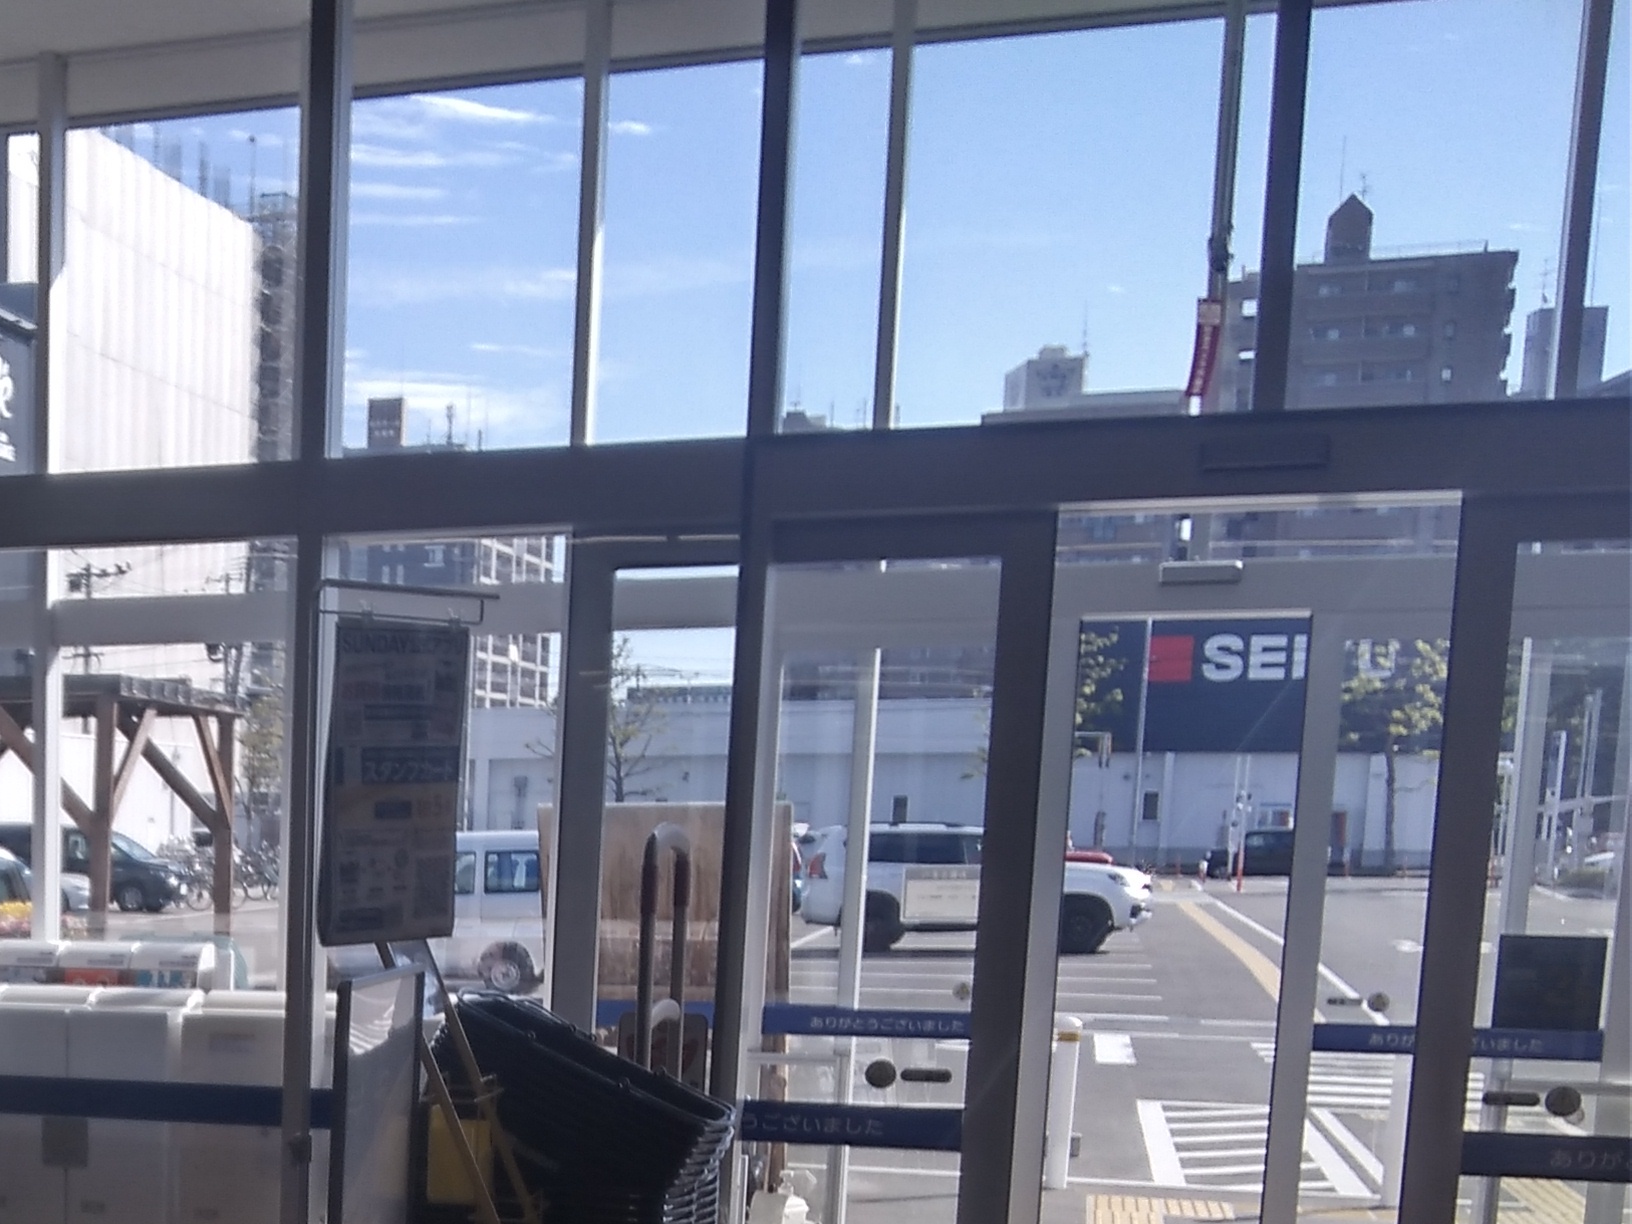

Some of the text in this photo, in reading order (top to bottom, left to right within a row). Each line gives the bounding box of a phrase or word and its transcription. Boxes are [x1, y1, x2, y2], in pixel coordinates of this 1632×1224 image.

[1202, 633, 1400, 682] SEIU
[809, 1015, 965, 1033] ありがとうございました
